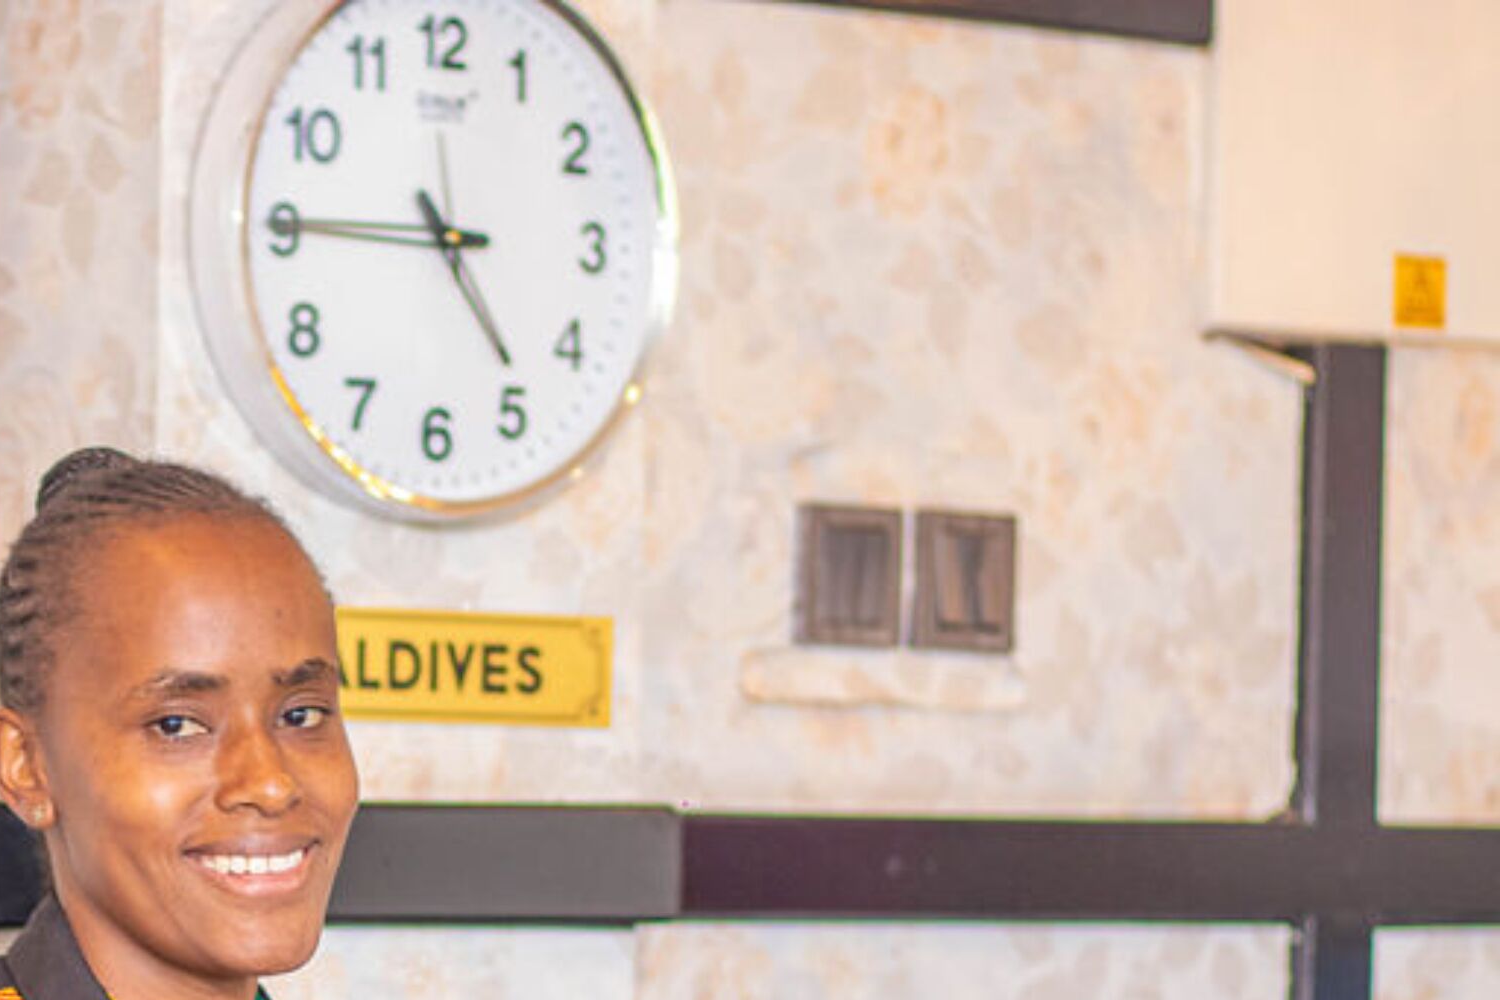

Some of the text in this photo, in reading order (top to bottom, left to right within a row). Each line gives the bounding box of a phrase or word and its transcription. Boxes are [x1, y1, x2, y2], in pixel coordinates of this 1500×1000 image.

[345, 35, 386, 91] 11
[418, 15, 468, 72] 12
[508, 49, 527, 103] 1
[284, 106, 342, 165] 10
[562, 121, 590, 176] 2
[266, 201, 303, 259] 9
[579, 221, 607, 276] 3
[287, 302, 321, 359] 8
[553, 318, 584, 371] 4
[344, 377, 377, 432] 7
[497, 385, 527, 441] 5
[421, 406, 453, 463] 6
